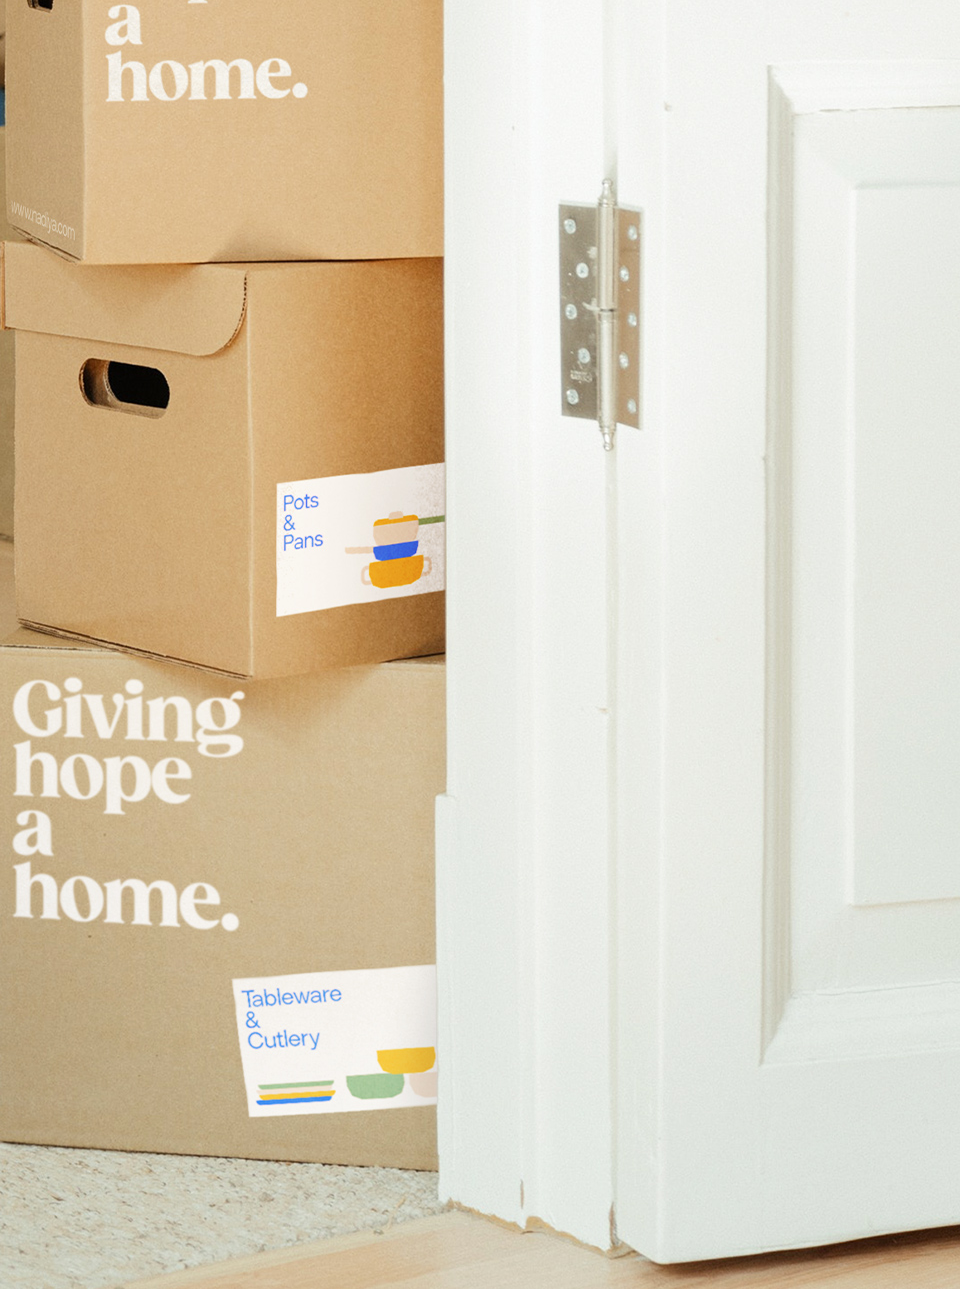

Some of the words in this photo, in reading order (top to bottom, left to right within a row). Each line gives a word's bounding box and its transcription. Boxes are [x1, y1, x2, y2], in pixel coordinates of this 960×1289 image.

[104, 4, 143, 46] a
[105, 50, 308, 102] home.
[283, 494, 320, 511] Pots
[283, 514, 296, 531] &
[283, 534, 324, 551] Pans
[13, 677, 245, 758] Giving
[13, 740, 192, 815] hope
[12, 810, 54, 856] a
[13, 861, 239, 932] home.
[241, 988, 343, 1008] Tableware
[245, 1011, 261, 1029] &
[247, 1030, 320, 1050] Cutlery
